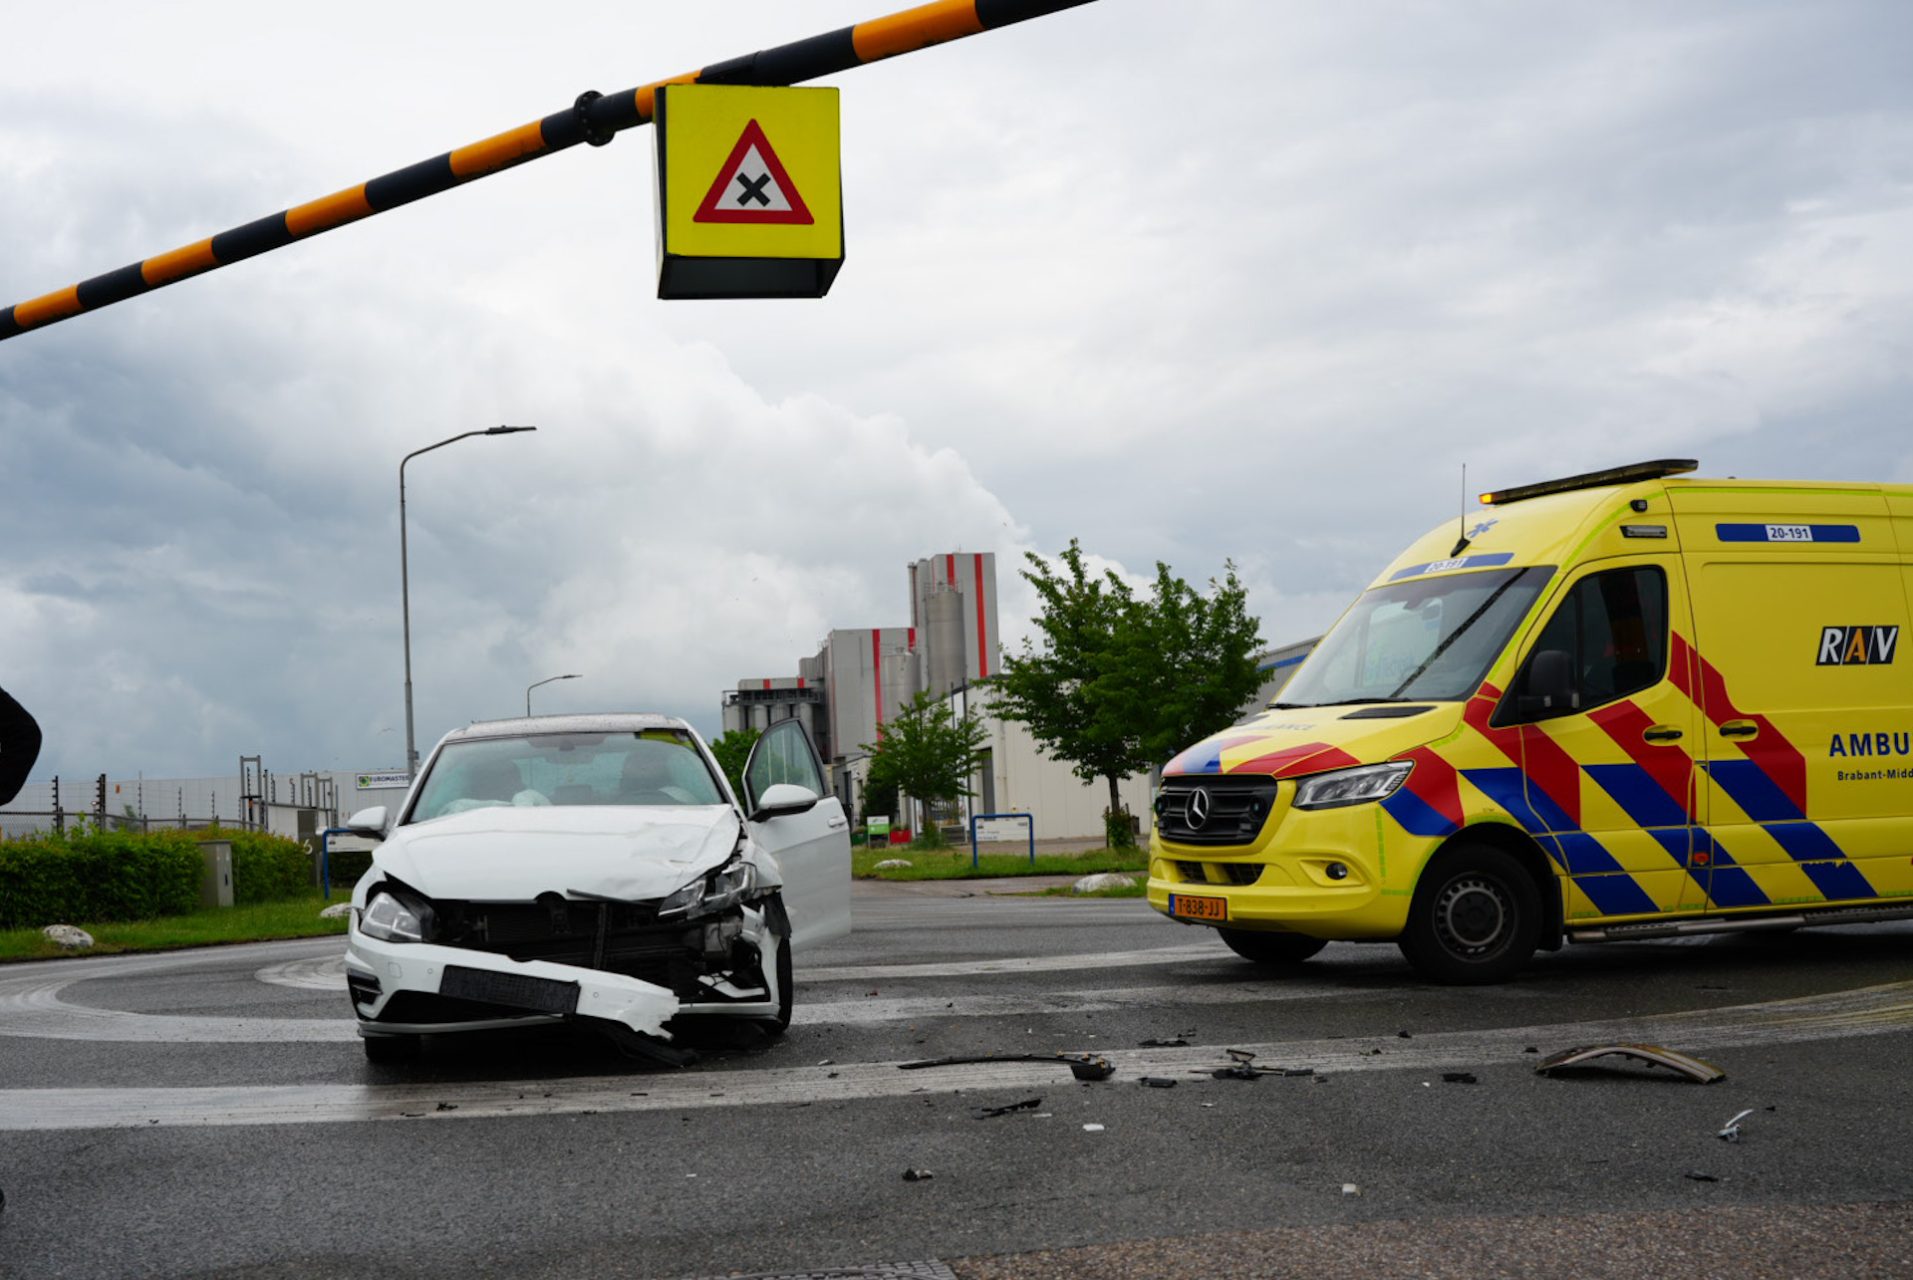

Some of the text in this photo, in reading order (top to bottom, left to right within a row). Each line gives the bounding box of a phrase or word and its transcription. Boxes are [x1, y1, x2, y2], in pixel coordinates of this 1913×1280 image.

[1770, 527, 1809, 539] 20-191
[1819, 627, 1898, 663] RAV
[1829, 732, 1910, 757] AMBU
[303, 838, 313, 855] 6
[1178, 898, 1220, 917] T-838-JJ
